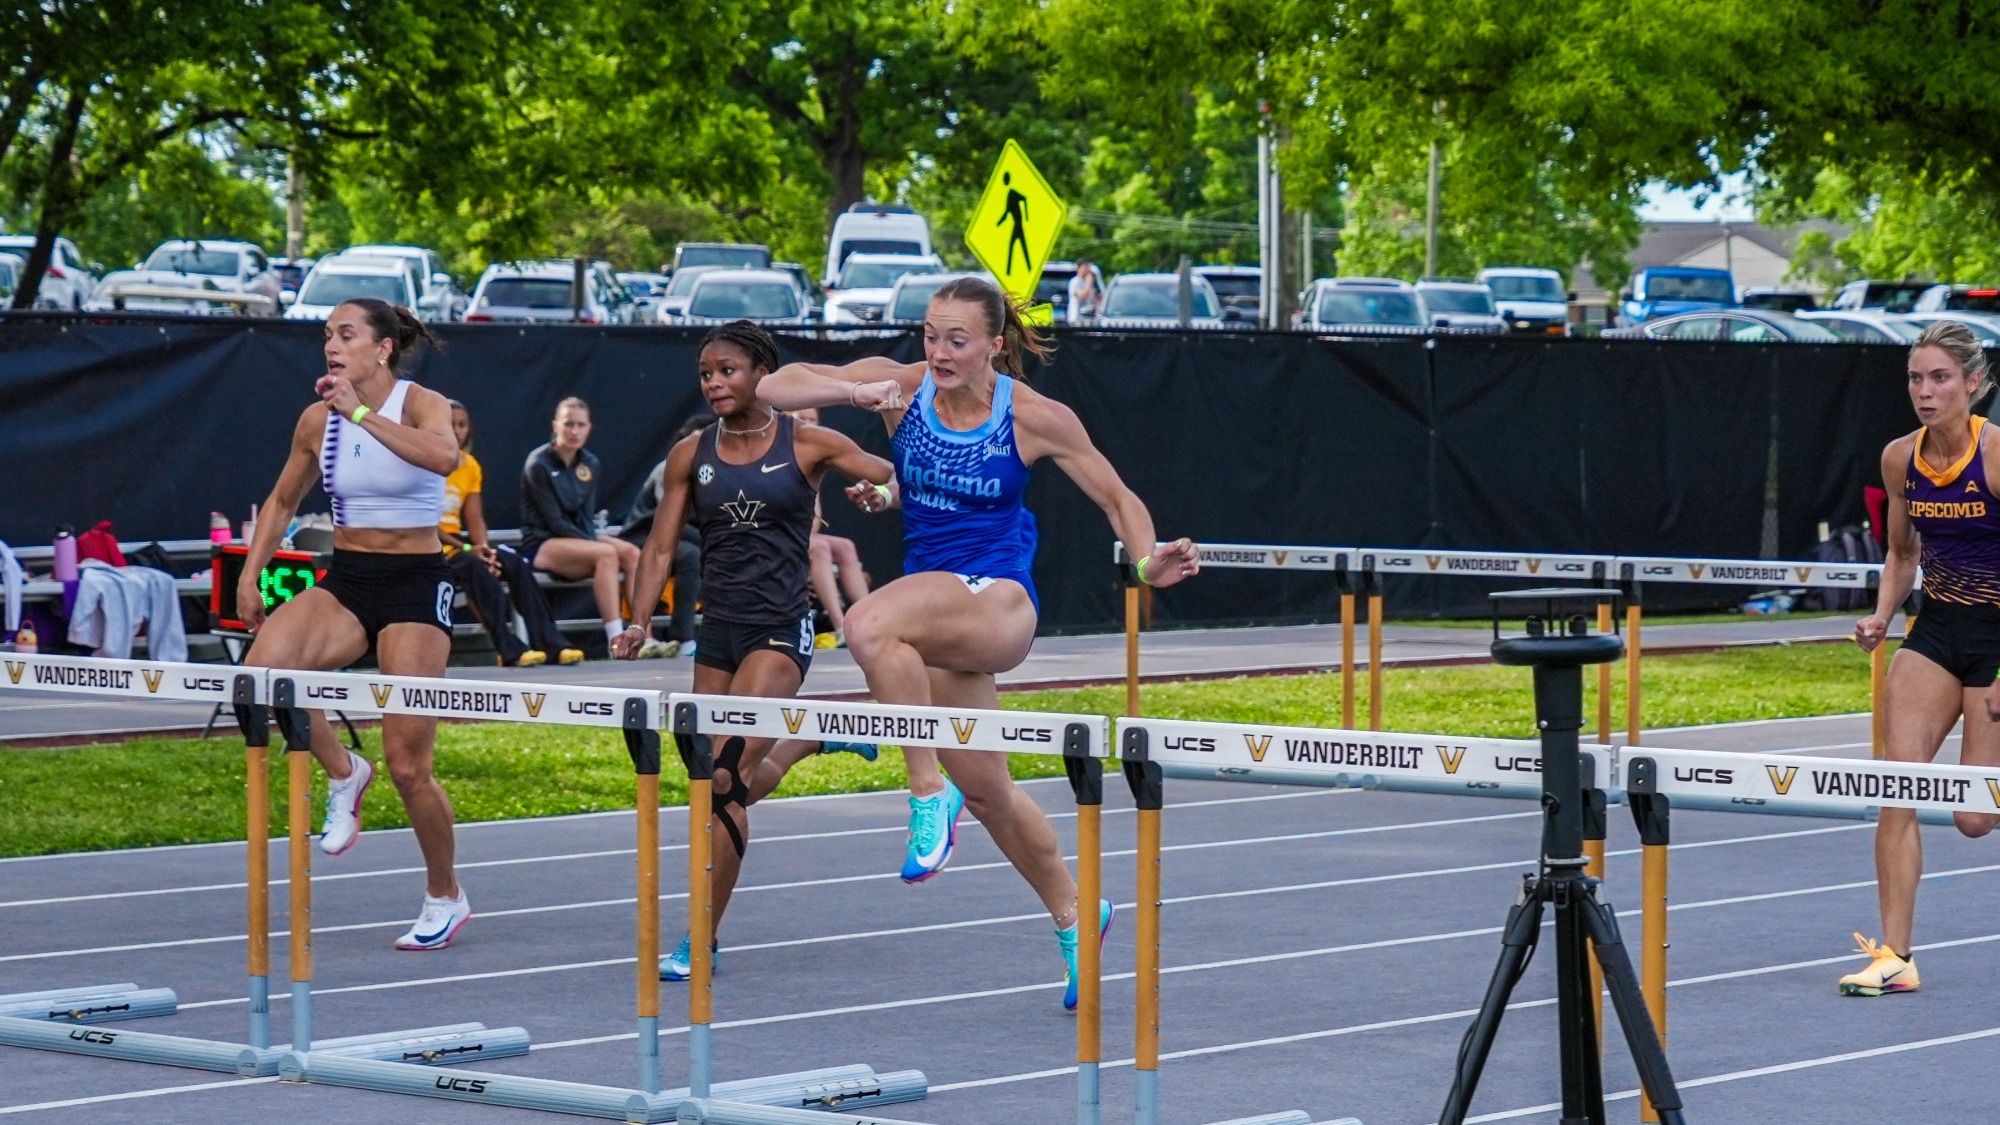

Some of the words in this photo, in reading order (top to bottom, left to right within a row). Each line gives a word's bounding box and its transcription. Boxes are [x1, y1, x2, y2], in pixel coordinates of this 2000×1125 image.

[903, 448, 1002, 498] Indiana
[1907, 499, 1986, 519] LIPSCOMB
[1300, 555, 1328, 564] UCS
[1383, 558, 1411, 567] UCS
[1447, 558, 1519, 571] VANDERBILT
[1555, 563, 1585, 572] UCS
[1643, 566, 1673, 576] UCS
[1711, 566, 1788, 581] VANDERBILT
[1826, 571, 1858, 581] UCS
[34, 665, 133, 689] VANDERBILT
[183, 677, 226, 692] UCS
[307, 686, 348, 700] UCS
[402, 687, 512, 714] VANDERBILT
[568, 701, 614, 716] UCS
[711, 710, 758, 726] UCS
[817, 712, 939, 740] VANDERBILT
[1002, 726, 1053, 743] UCS
[1164, 736, 1216, 752] UCS
[1285, 739, 1424, 770] VANDERBILT
[1674, 766, 1735, 785] UCS
[1812, 770, 1971, 804] VANDERBILT
[69, 1030, 118, 1044] UCS
[436, 1075, 491, 1093] UCS
